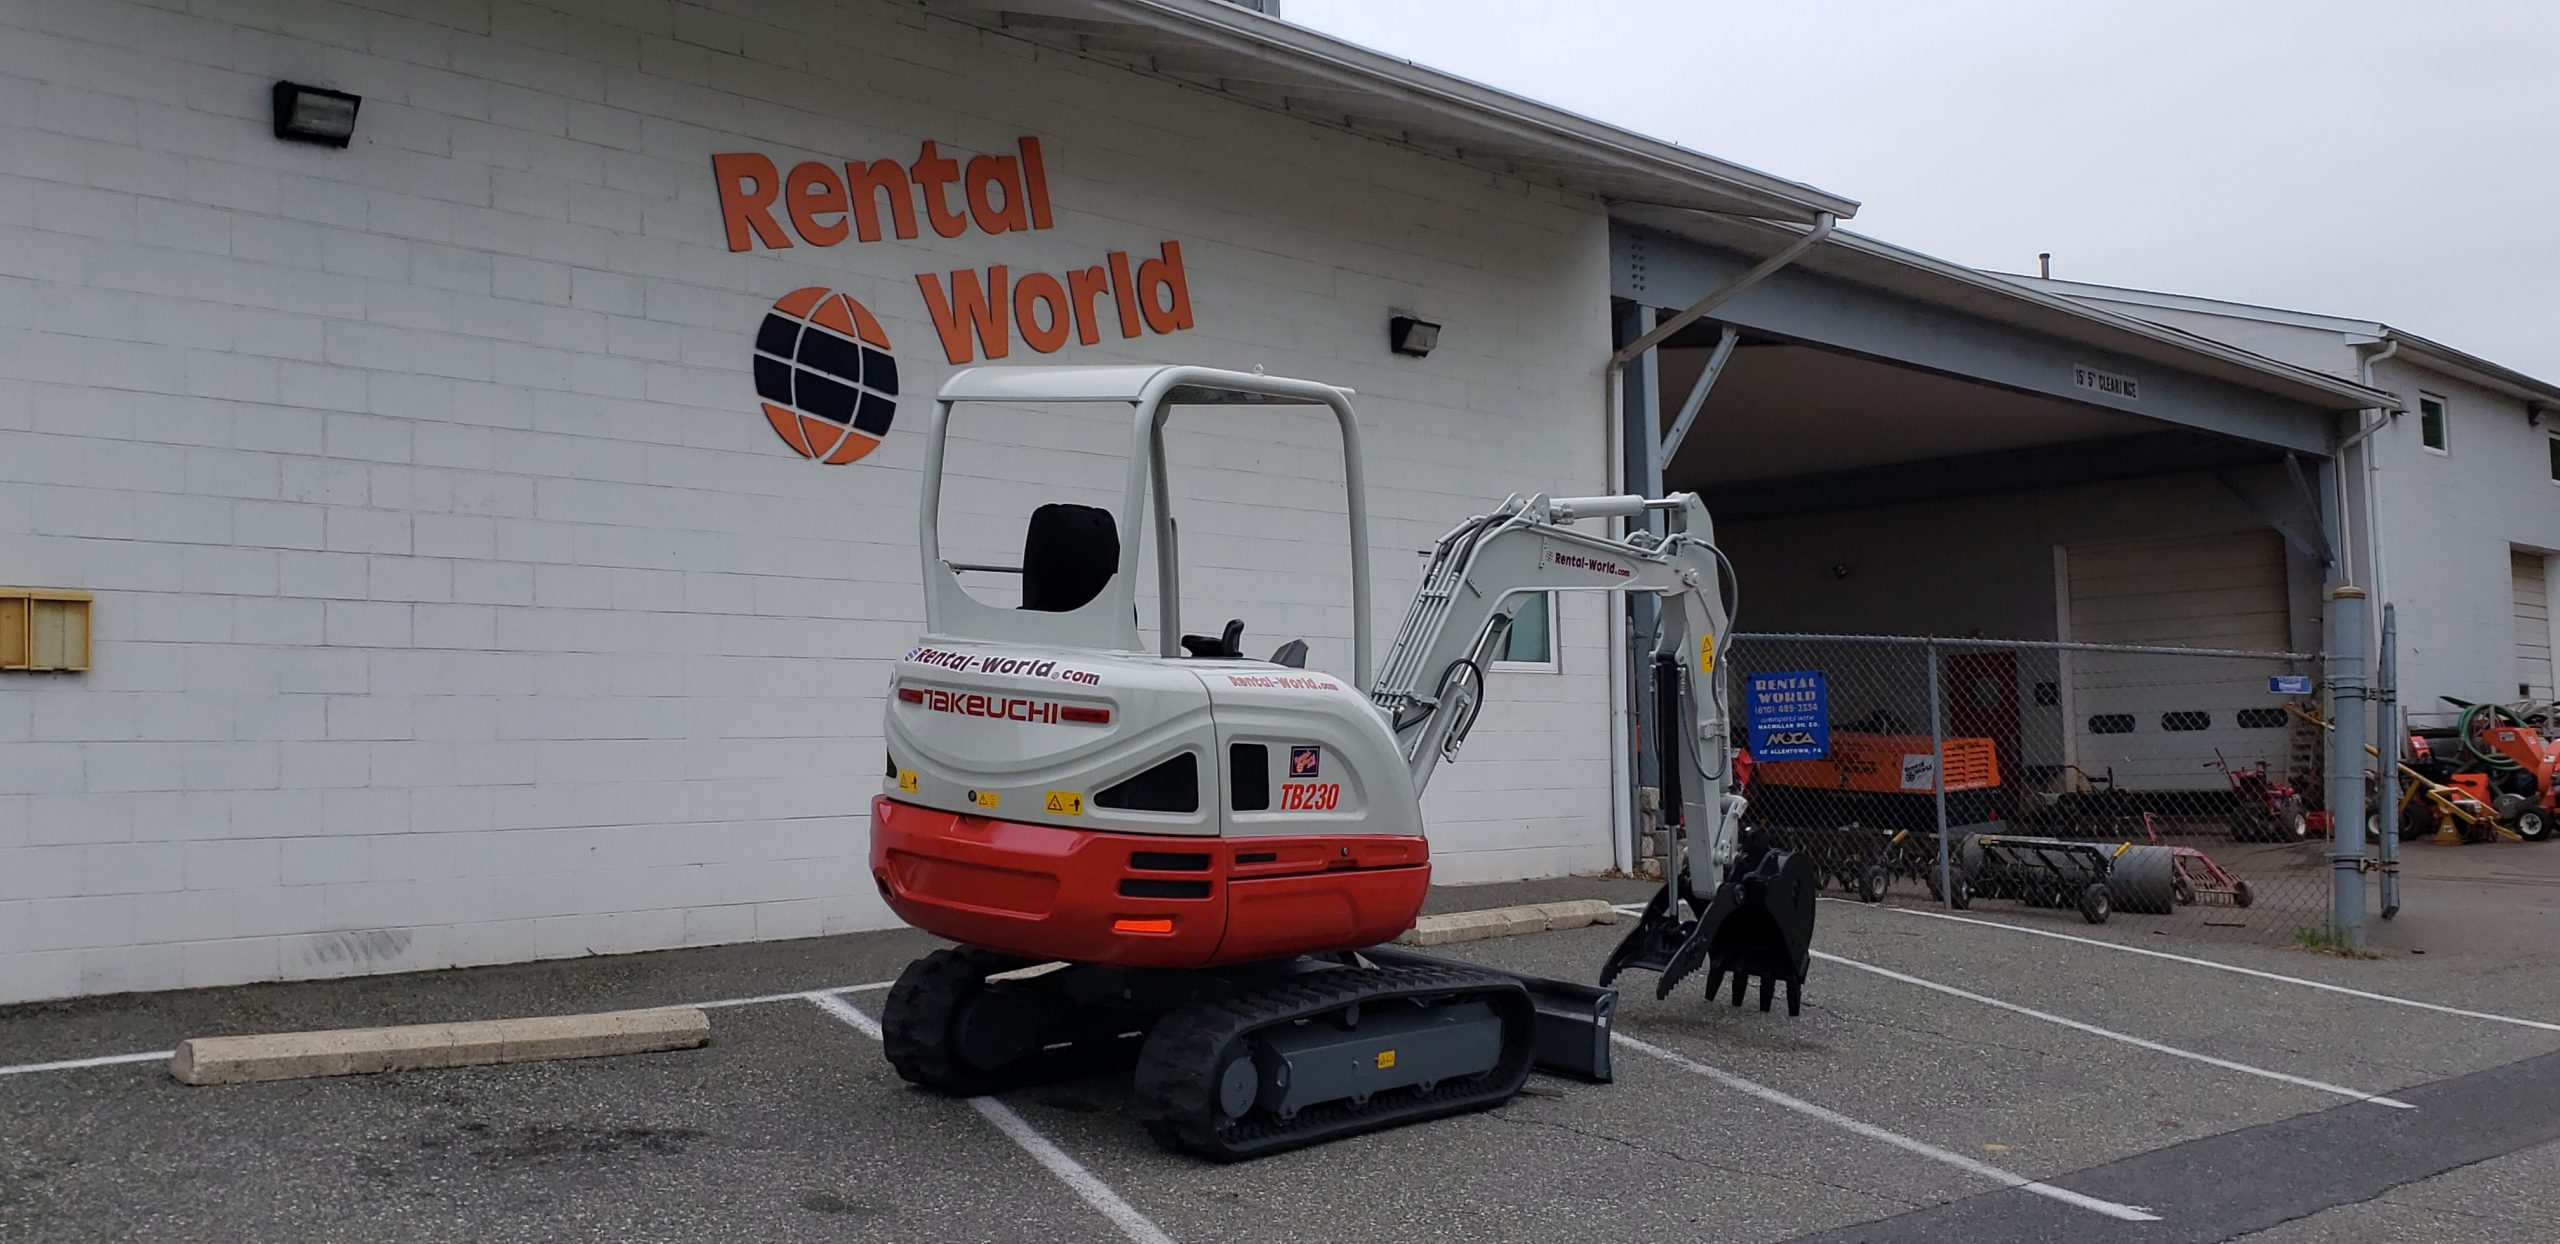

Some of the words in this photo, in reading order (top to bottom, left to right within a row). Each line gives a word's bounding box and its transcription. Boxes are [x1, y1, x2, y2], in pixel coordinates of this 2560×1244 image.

[712, 136, 1054, 252] Rental
[915, 240, 1194, 365] World
[1555, 552, 1631, 577] Rental-World.com
[1755, 678, 1817, 691] RENTAL
[923, 689, 1058, 724] TAKEUCHI
[1754, 705, 1775, 714] (610)
[1758, 691, 1816, 704] WORLD
[1766, 732, 1817, 746] NOCA
[1280, 783, 1340, 811] TB230
